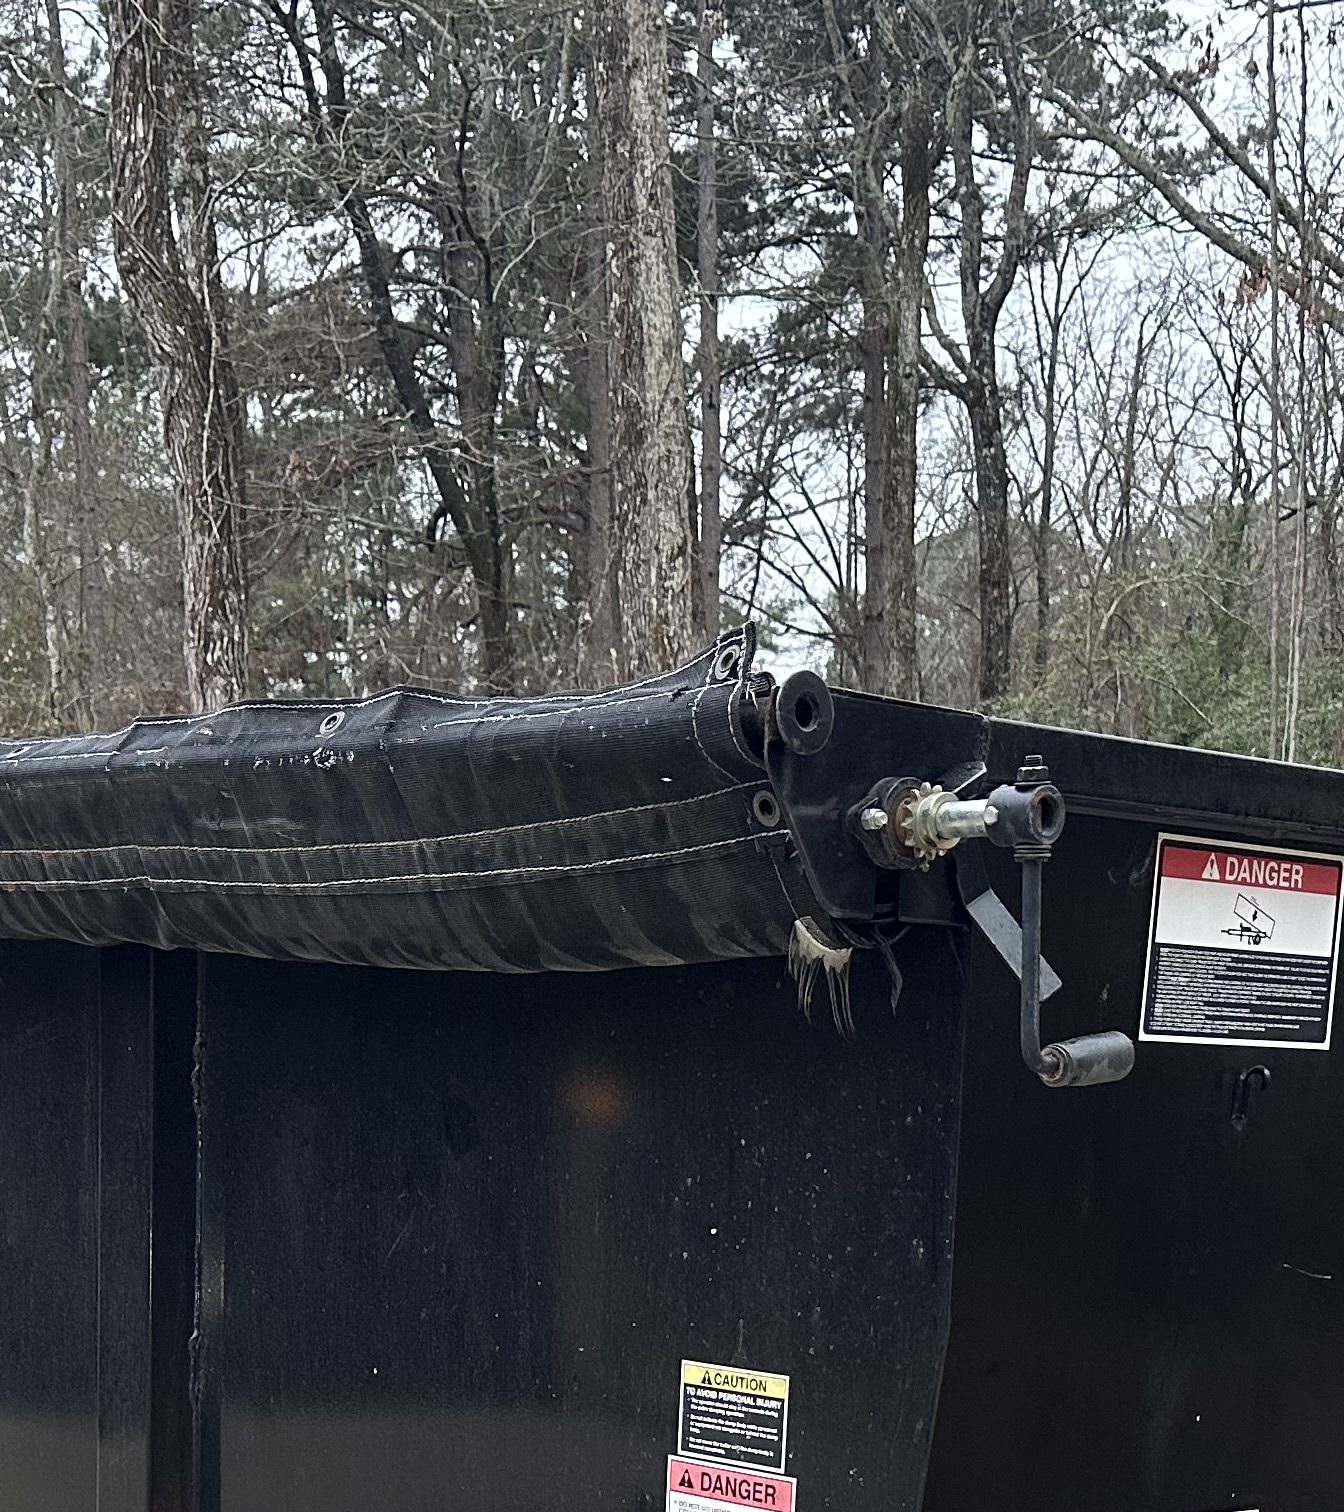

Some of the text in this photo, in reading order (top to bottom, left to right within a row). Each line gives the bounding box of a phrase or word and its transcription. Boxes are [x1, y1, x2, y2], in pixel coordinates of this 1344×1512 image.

[1225, 856, 1304, 889] DANGER
[714, 1373, 767, 1393] CAUTION
[700, 1471, 777, 1506] DANGER
